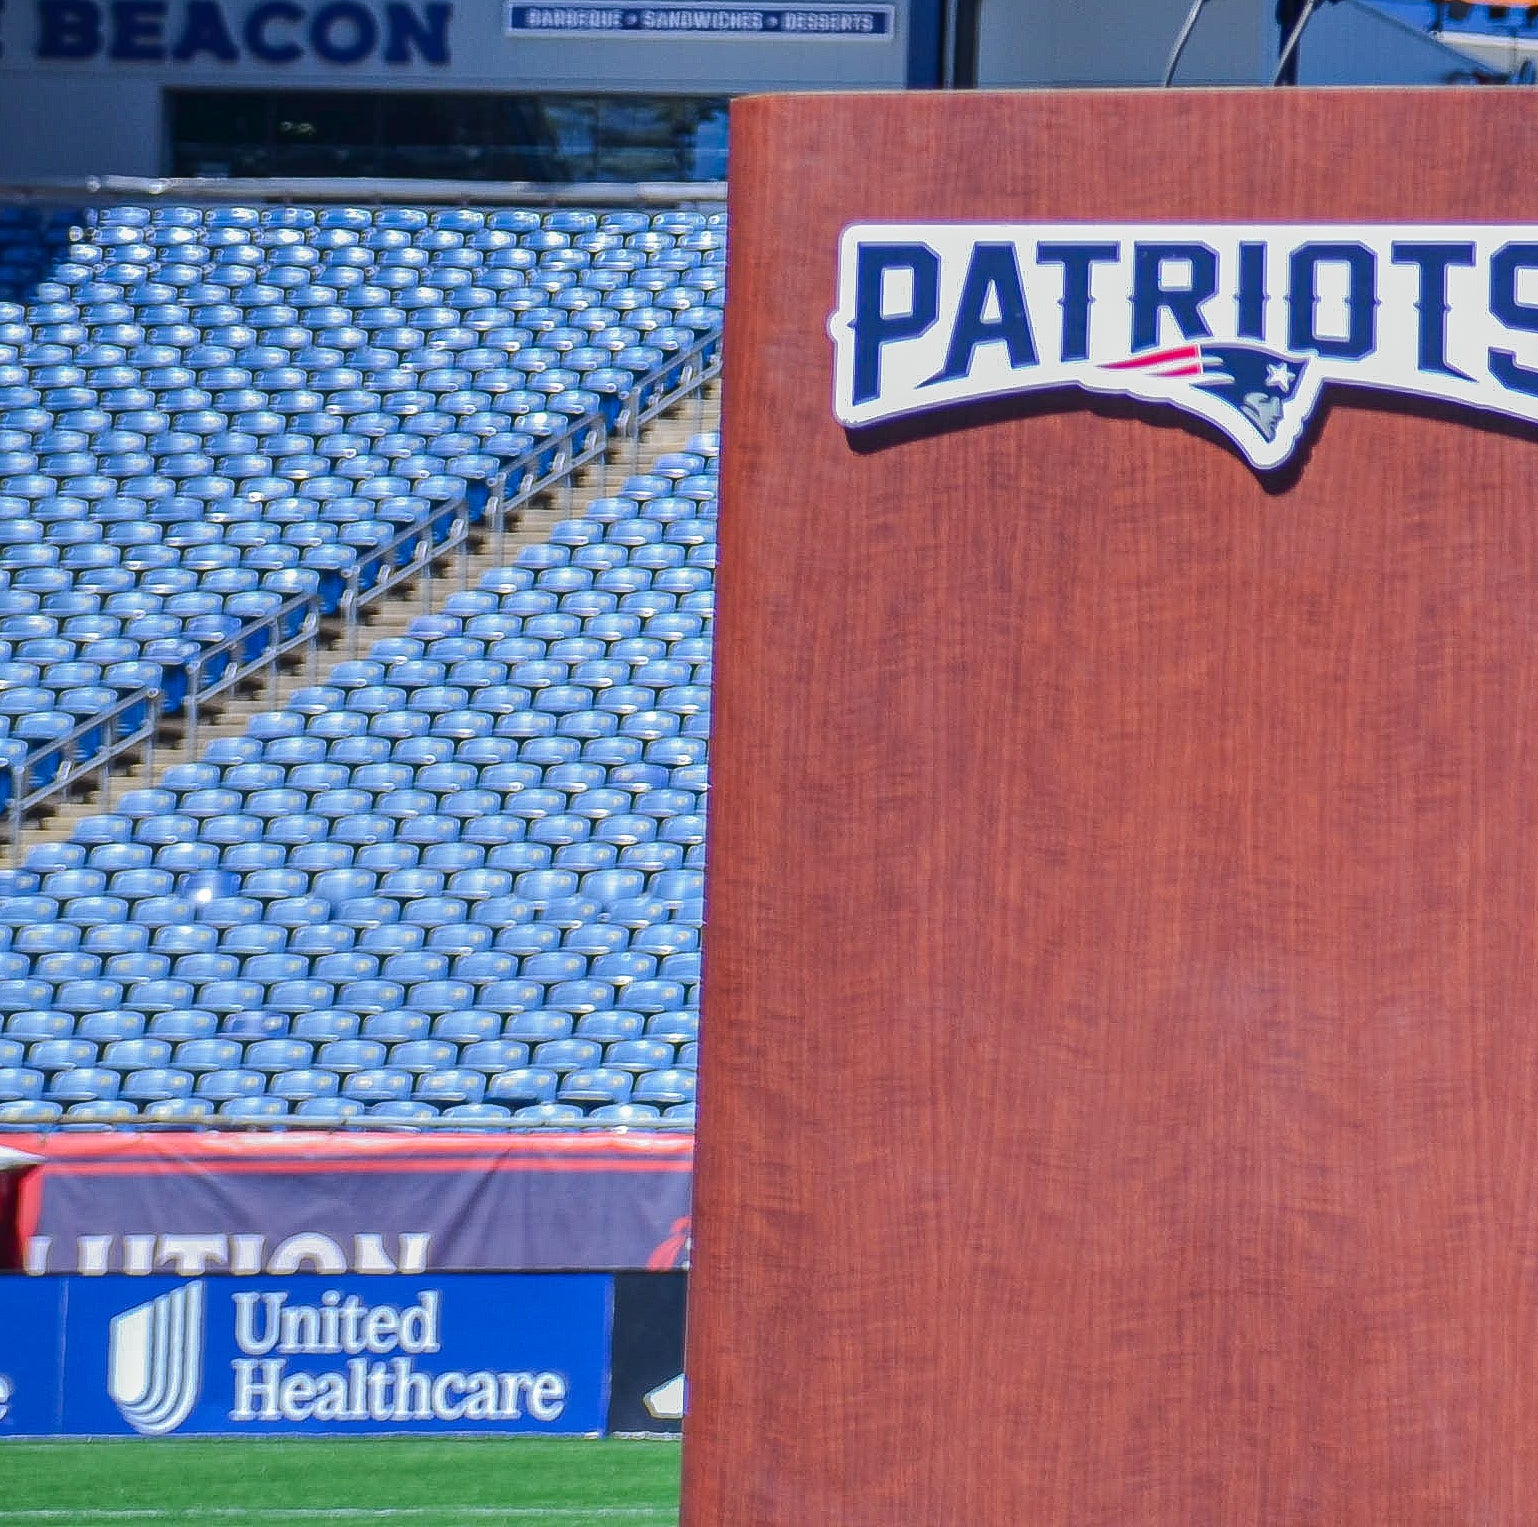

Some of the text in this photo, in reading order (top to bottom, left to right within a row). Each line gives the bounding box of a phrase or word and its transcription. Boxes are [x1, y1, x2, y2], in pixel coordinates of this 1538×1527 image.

[641, 8, 764, 31] SANDWICHES
[783, 10, 874, 33] DESSERTS
[231, 1289, 442, 1355] United
[228, 1356, 567, 1422] Healthcare
